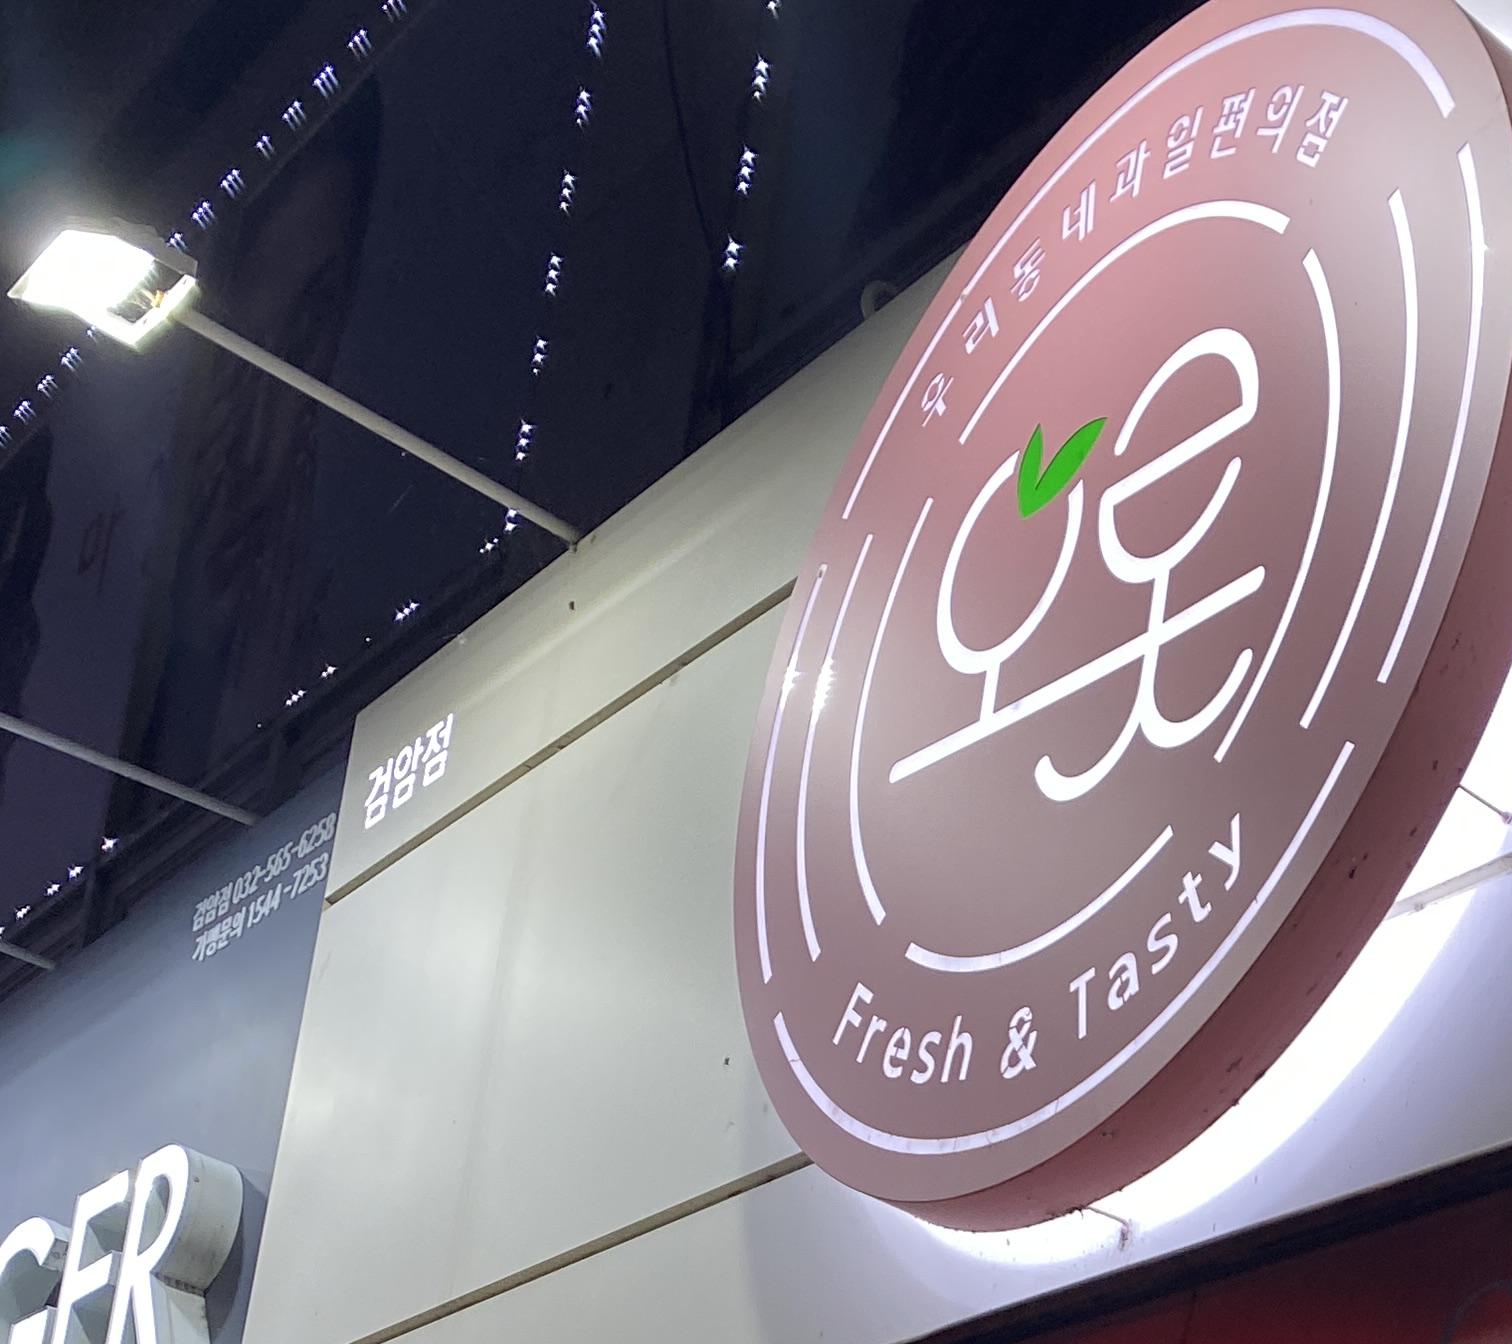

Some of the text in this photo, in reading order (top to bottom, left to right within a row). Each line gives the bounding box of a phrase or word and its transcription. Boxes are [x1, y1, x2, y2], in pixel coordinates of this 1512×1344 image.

[364, 713, 454, 829] 검암점
[191, 852, 330, 962] 가맹문의 1544-7253
[192, 882, 234, 932] 검암점
[833, 811, 1245, 1087] Fresh & Tasty
